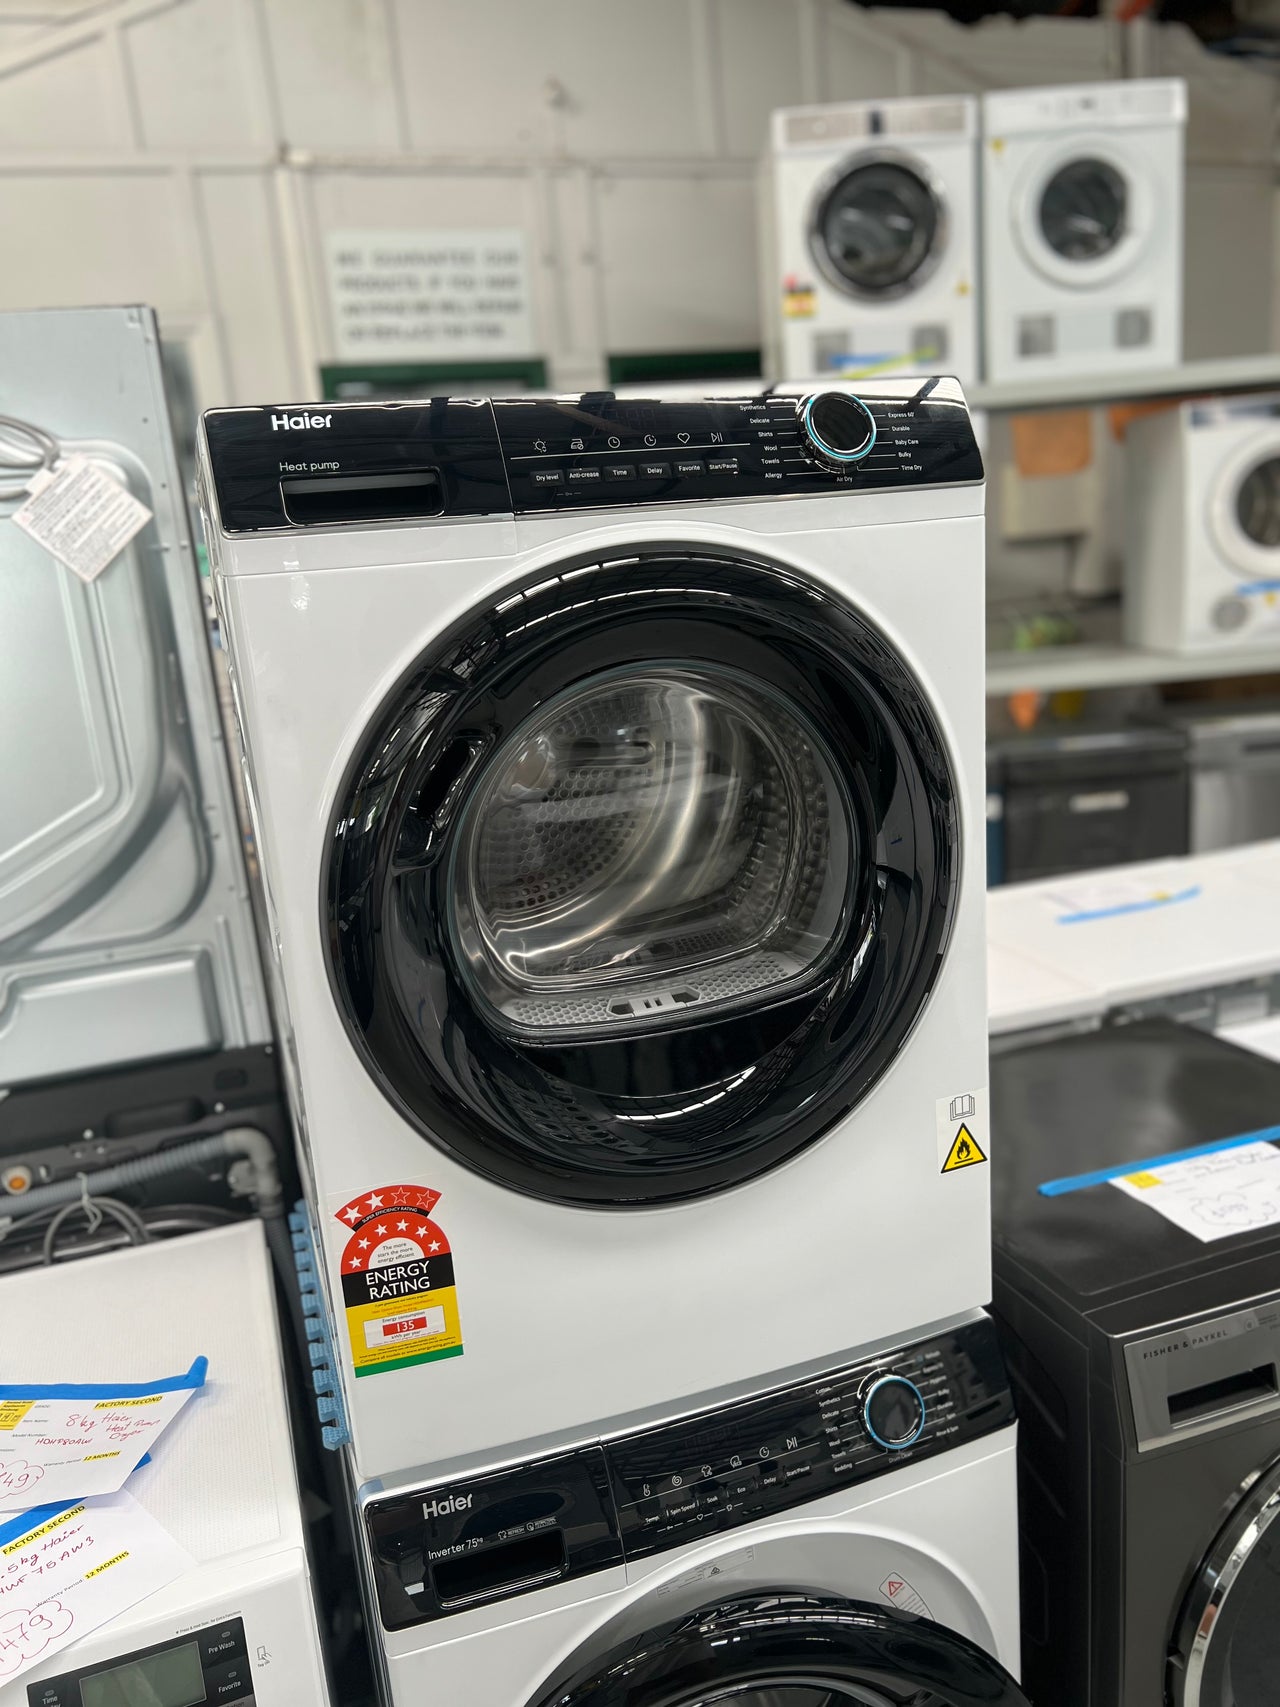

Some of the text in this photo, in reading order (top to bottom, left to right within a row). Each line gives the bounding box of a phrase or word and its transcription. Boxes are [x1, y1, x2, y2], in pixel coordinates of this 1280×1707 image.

[271, 413, 333, 431] Haier
[279, 459, 340, 474] Heat pump
[362, 1212, 376, 1224] SUPER
[375, 1206, 400, 1216] EFFICIENCY
[366, 1260, 430, 1286] ENERGY
[370, 1276, 430, 1300] RATING
[382, 1311, 425, 1323] Energy consumption
[396, 1320, 415, 1332] 135
[1143, 1344, 1179, 1360] FISHER
[1192, 1330, 1228, 1346] PAYKEL
[94, 1396, 162, 1409] FACTORY SECOND
[819, 1396, 840, 1407] Synthetics
[822, 1410, 840, 1420] Delicate
[826, 1425, 838, 1434] Shirts
[828, 1438, 841, 1448] Wool
[888, 1456, 900, 1464] Drum
[786, 1465, 810, 1477] Start/Pause
[764, 1476, 777, 1486] Delay
[422, 1493, 473, 1520] Haier
[706, 1496, 718, 1504] Soak
[670, 1502, 696, 1516] Spin Speed
[2, 1505, 85, 1554] FACTORY SECOND
[41, 1524, 84, 1551] Haier
[428, 1542, 466, 1561] Inverter
[36, 1590, 64, 1608] Warranty
[84, 1571, 95, 1580] 12
[96, 1551, 130, 1573] MONTHS
[208, 1640, 236, 1655] Pre Wash
[218, 1680, 242, 1694] Favorite
[42, 1696, 58, 1705] Time
